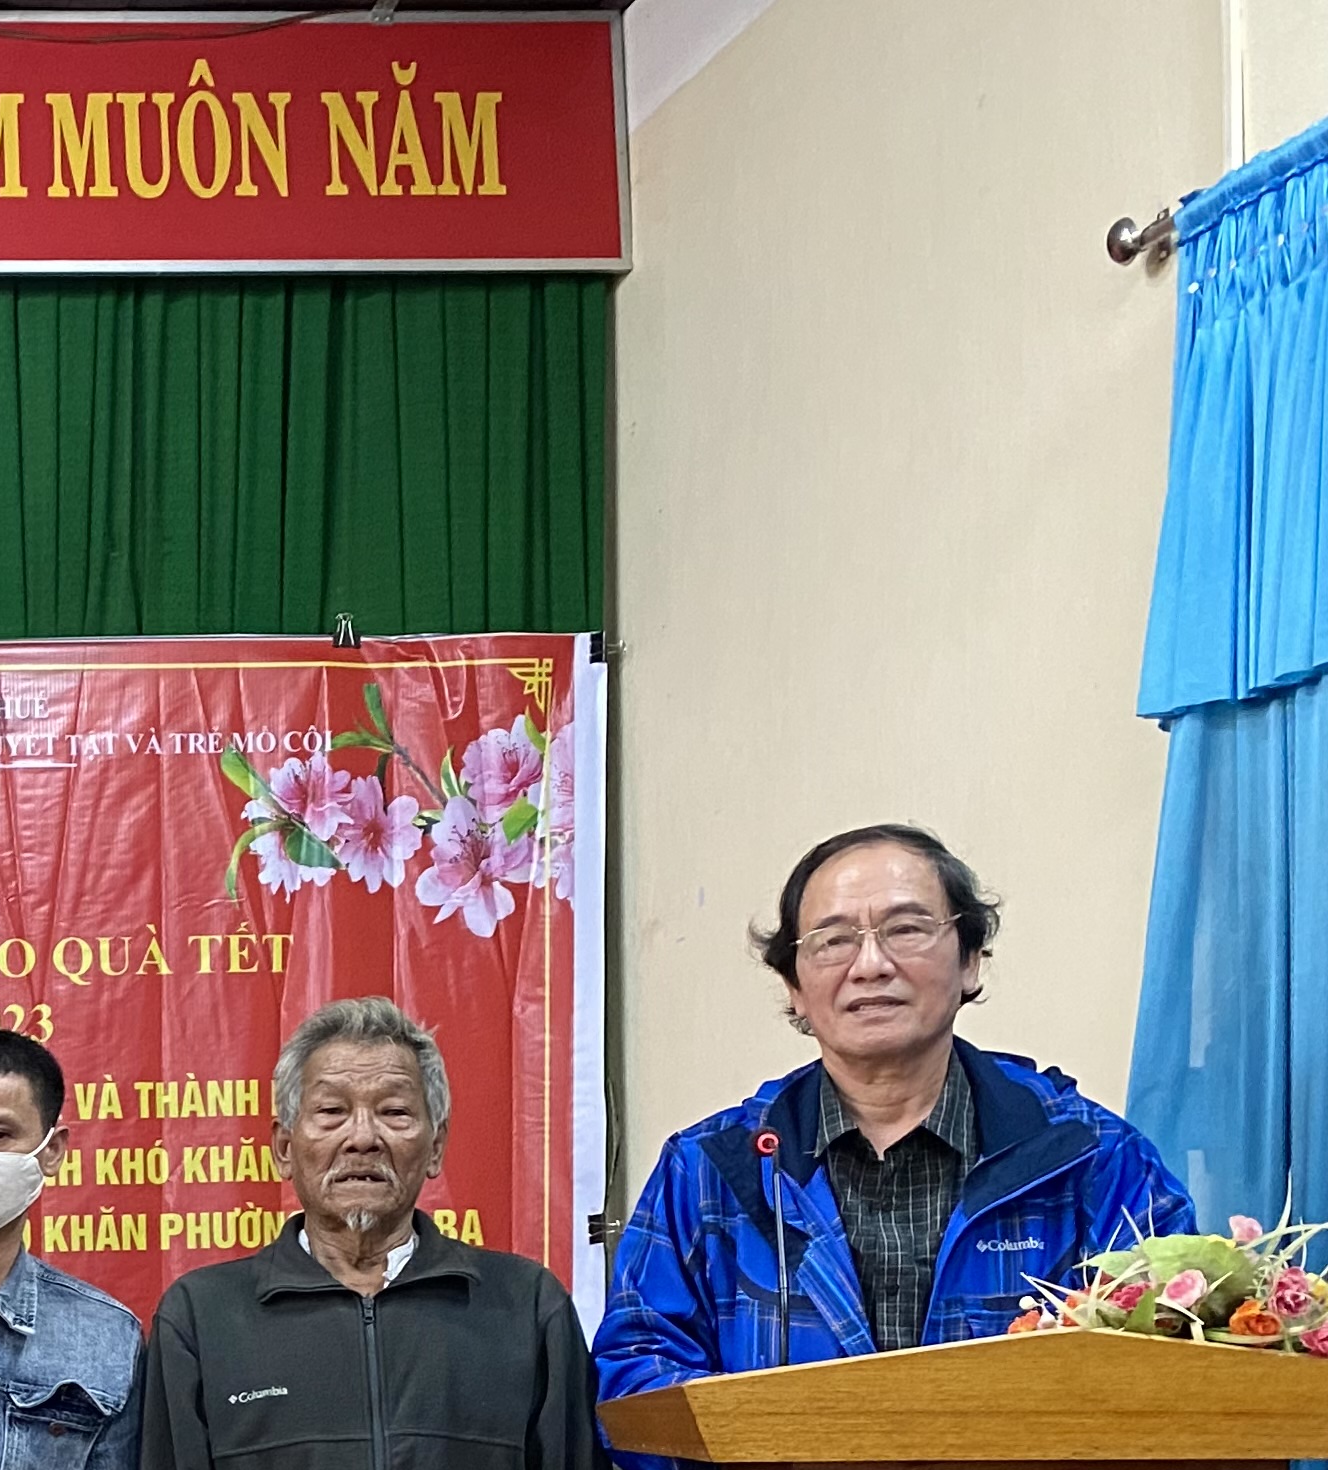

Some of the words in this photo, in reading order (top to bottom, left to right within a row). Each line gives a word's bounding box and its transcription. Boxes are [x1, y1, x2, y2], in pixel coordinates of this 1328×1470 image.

[45, 58, 292, 200] MUÔN
[320, 62, 507, 199] NĂM
[65, 730, 119, 761] TẬT
[125, 726, 163, 754] VÀ
[169, 726, 224, 754] TRẺ
[283, 725, 333, 753] CÔI
[52, 924, 174, 986] QUÀ
[188, 921, 295, 975] TẾT
[73, 1074, 124, 1121] VÀ
[133, 1072, 260, 1119] THÀNH
[95, 1140, 170, 1186] KHÓ
[183, 1137, 283, 1184] KHĂN
[44, 1206, 147, 1253] KHĂN
[159, 1202, 286, 1251] PHƯỜN
[238, 1386, 288, 1403] Columbia
